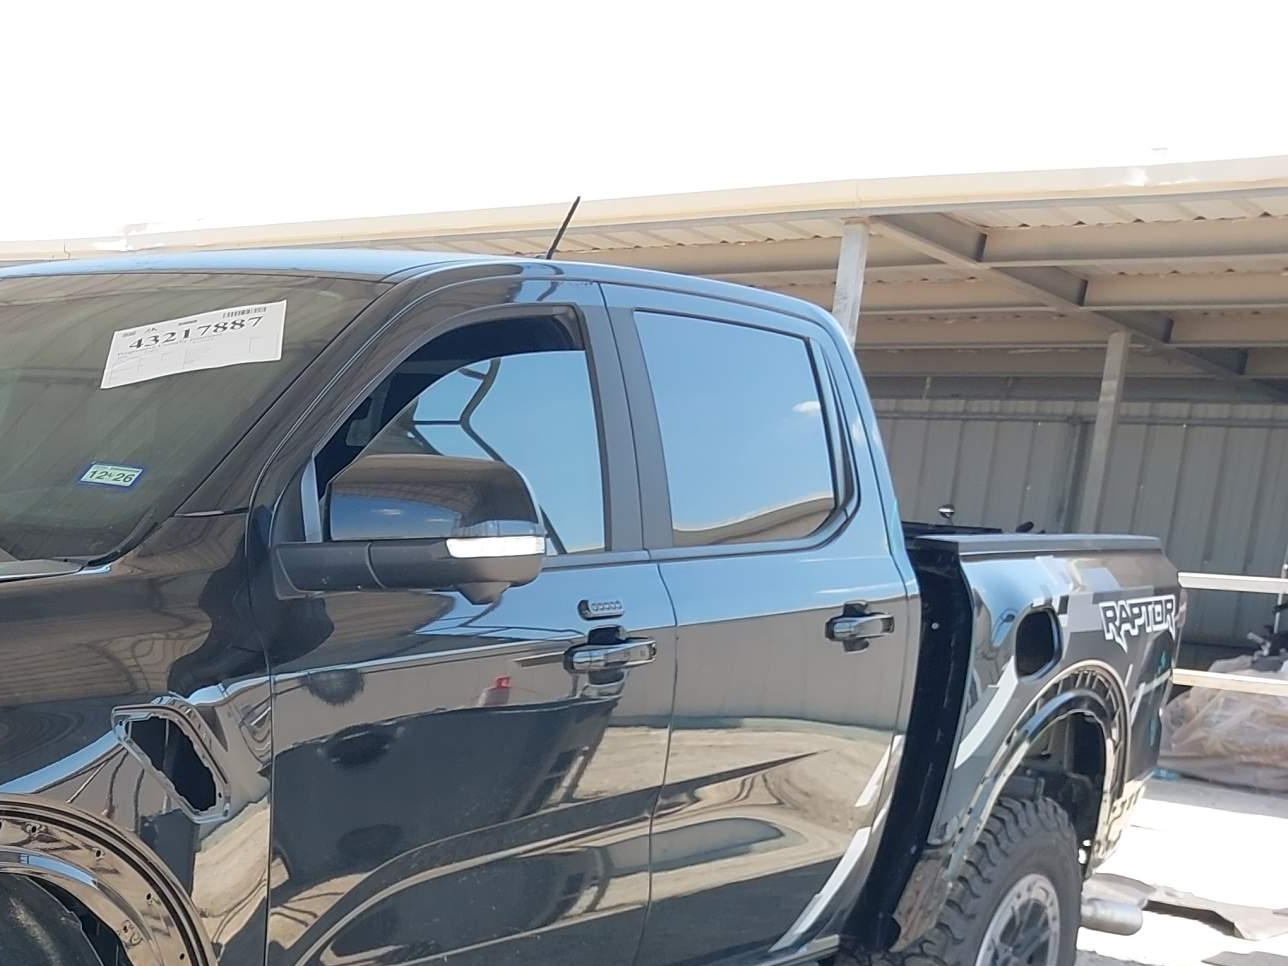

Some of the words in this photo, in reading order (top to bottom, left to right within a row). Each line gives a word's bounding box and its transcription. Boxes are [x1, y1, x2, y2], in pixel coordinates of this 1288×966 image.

[128, 316, 264, 350] 43217887
[113, 472, 136, 483] 26
[1099, 594, 1176, 653] RAPTOR
